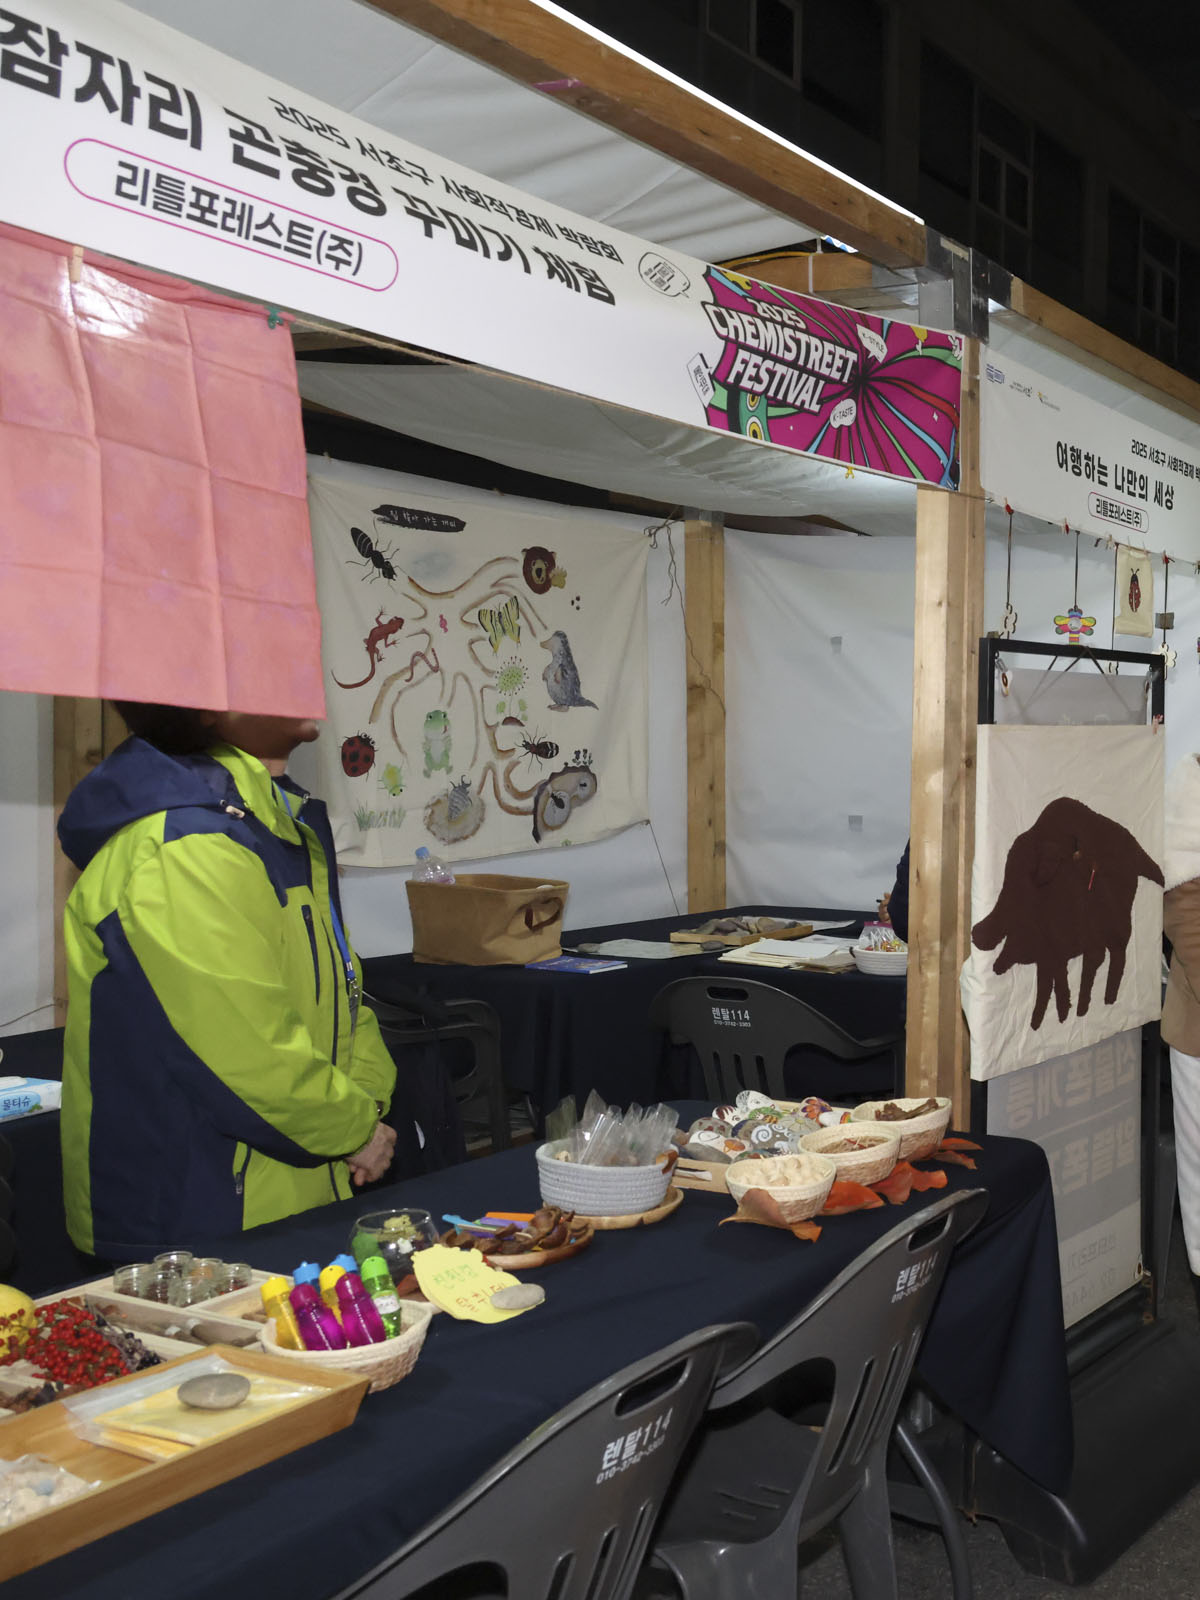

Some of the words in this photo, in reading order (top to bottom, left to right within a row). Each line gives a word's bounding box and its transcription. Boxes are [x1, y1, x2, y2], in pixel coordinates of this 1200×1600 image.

[0, 9, 202, 150] 잠자리
[223, 107, 388, 217] 곤충경
[391, 186, 532, 275] 꾸미기
[530, 246, 617, 305] 체험
[268, 97, 350, 148] 2025
[355, 137, 433, 185] 서초구
[442, 175, 558, 240] 사회적경제
[562, 223, 624, 264] 박람회
[115, 160, 364, 279] 리틀포레스트(주)
[747, 297, 806, 330] 2025
[706, 303, 857, 384] CHEMISTREET
[862, 331, 885, 353] K-STYLE
[727, 348, 825, 412] FESTIVAL
[833, 404, 854, 423] K-TASTE
[1056, 440, 1108, 487] 여행하는
[1114, 463, 1148, 502] 나만의
[1154, 480, 1175, 510] 세상
[1131, 439, 1148, 459] 2025
[1148, 447, 1166, 467] 서초구
[1167, 455, 1195, 479] 사회적경제
[1096, 498, 1142, 529] 리틀포레스트(주)
[711, 1006, 750, 1021] 렌탈114
[3, 1095, 32, 1111] 물티슈
[602, 1407, 673, 1471] 렌탈114
